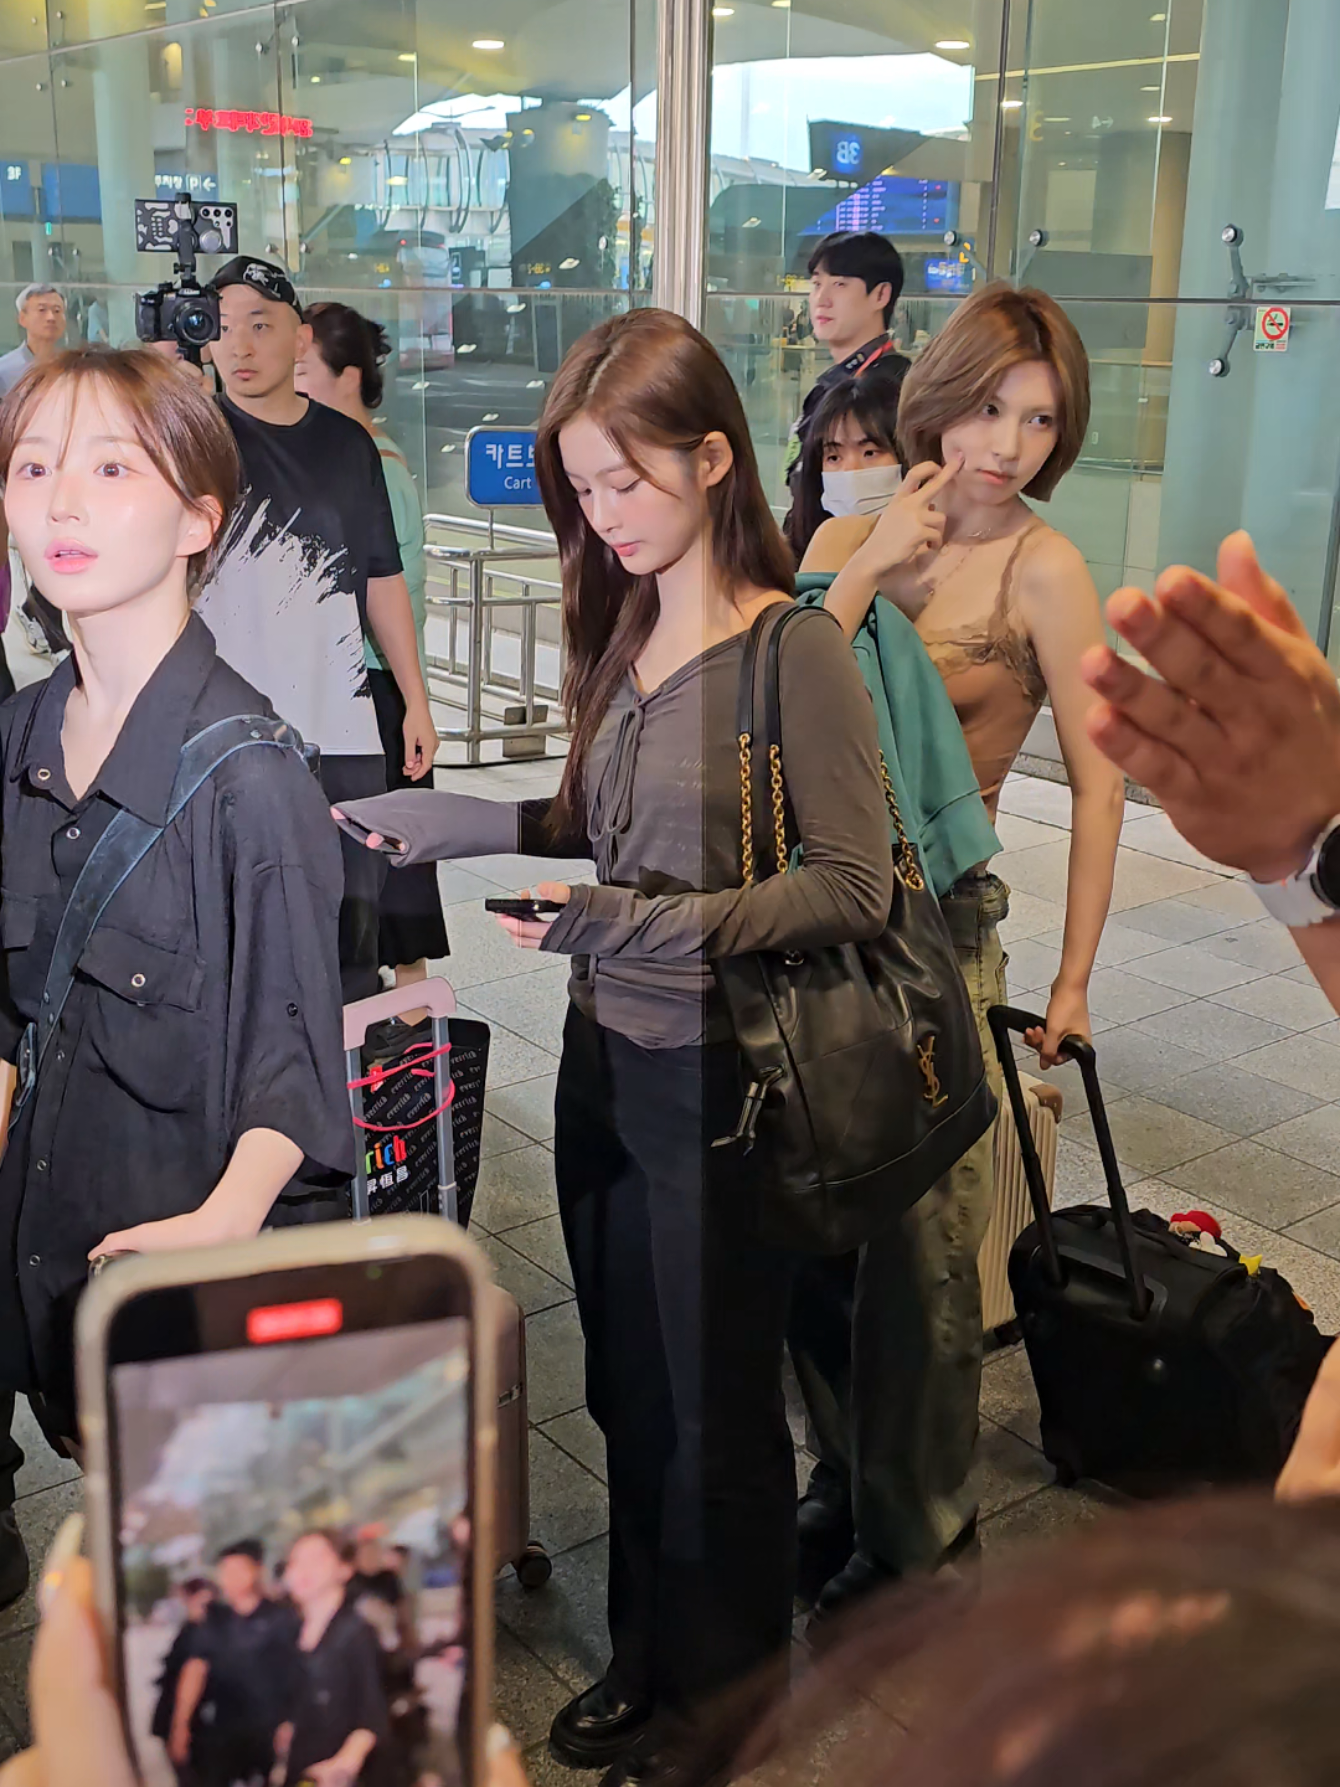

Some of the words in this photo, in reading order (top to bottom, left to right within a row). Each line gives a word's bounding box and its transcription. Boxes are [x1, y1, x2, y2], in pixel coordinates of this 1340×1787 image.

[504, 476, 531, 489] Cart
[450, 1051, 477, 1064] verrich
[366, 1135, 407, 1174] rich
